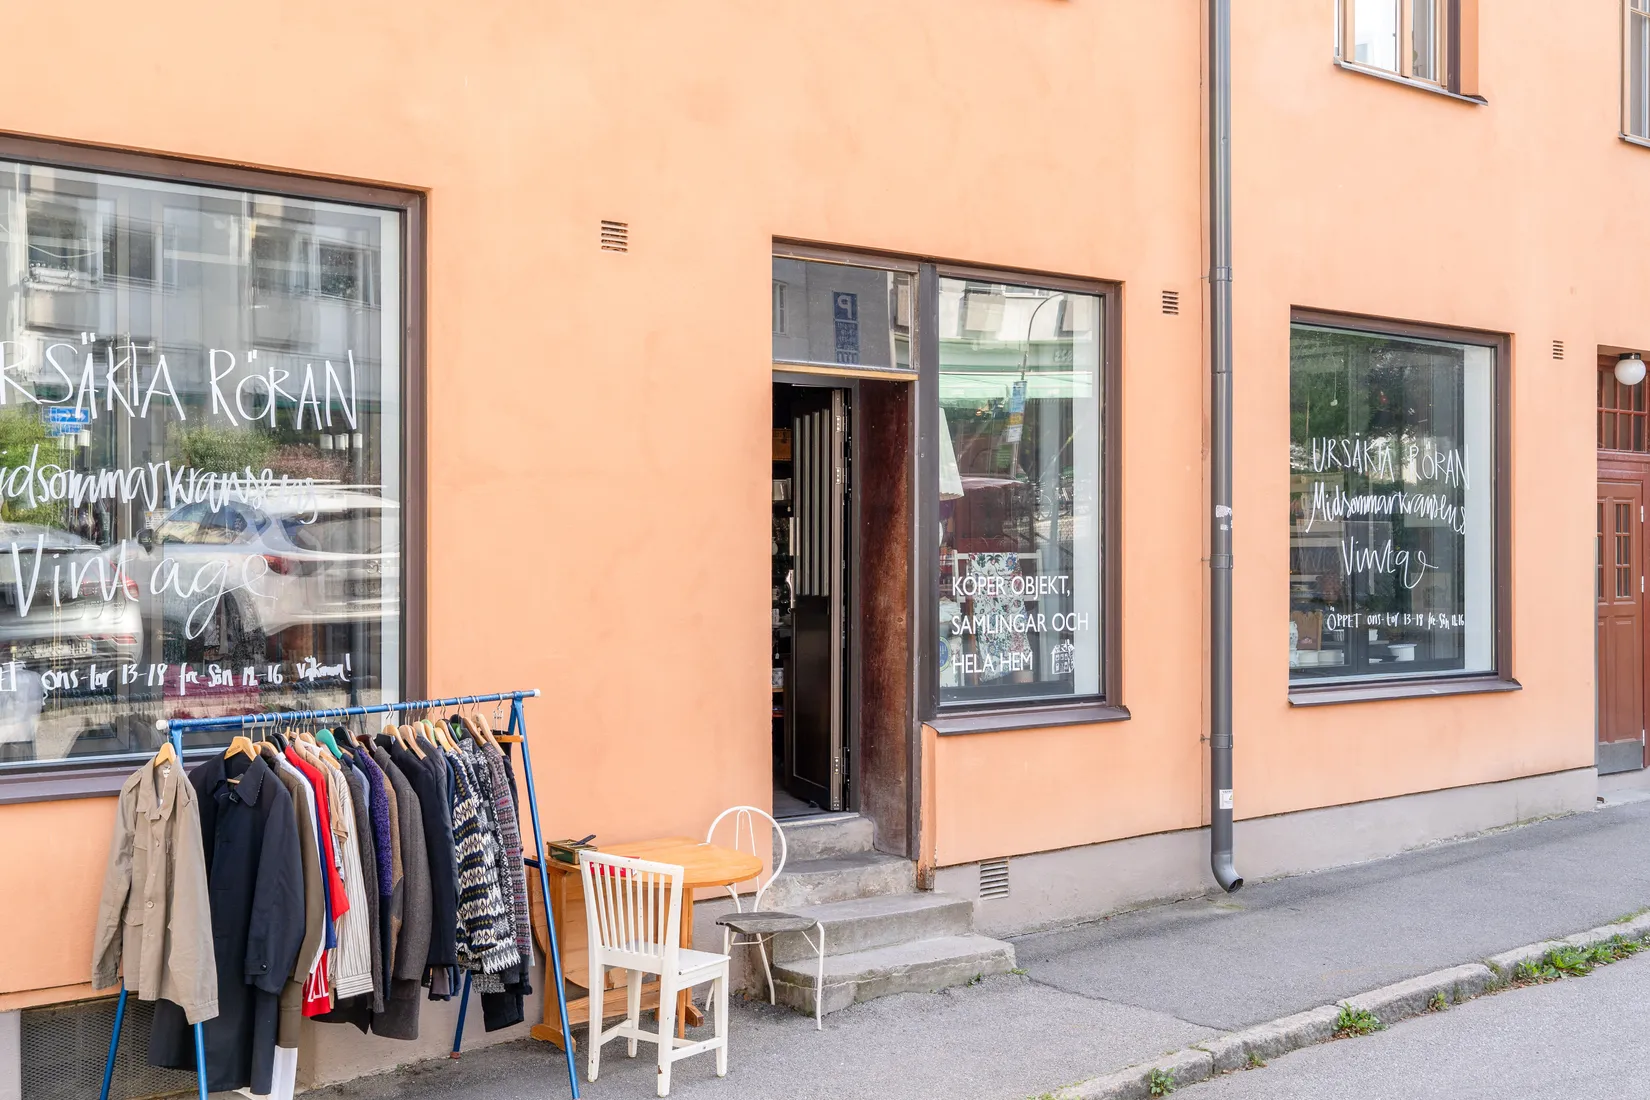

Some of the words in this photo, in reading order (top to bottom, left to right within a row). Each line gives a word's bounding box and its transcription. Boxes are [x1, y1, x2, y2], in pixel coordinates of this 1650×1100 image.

[209, 349, 357, 430] RÖRAN
[1312, 432, 1395, 483] URSÄKTA
[1409, 441, 1470, 490] RÖRAN
[12, 533, 279, 640] Vintage
[952, 572, 1006, 596] KÖPER
[1011, 575, 1071, 600] OBJEKT,
[951, 613, 1047, 635] SAMLINGAR
[1051, 612, 1089, 632] OCH
[1326, 605, 1362, 631] ÖPPET
[952, 653, 995, 674] HELA
[1000, 652, 1033, 671] HEM
